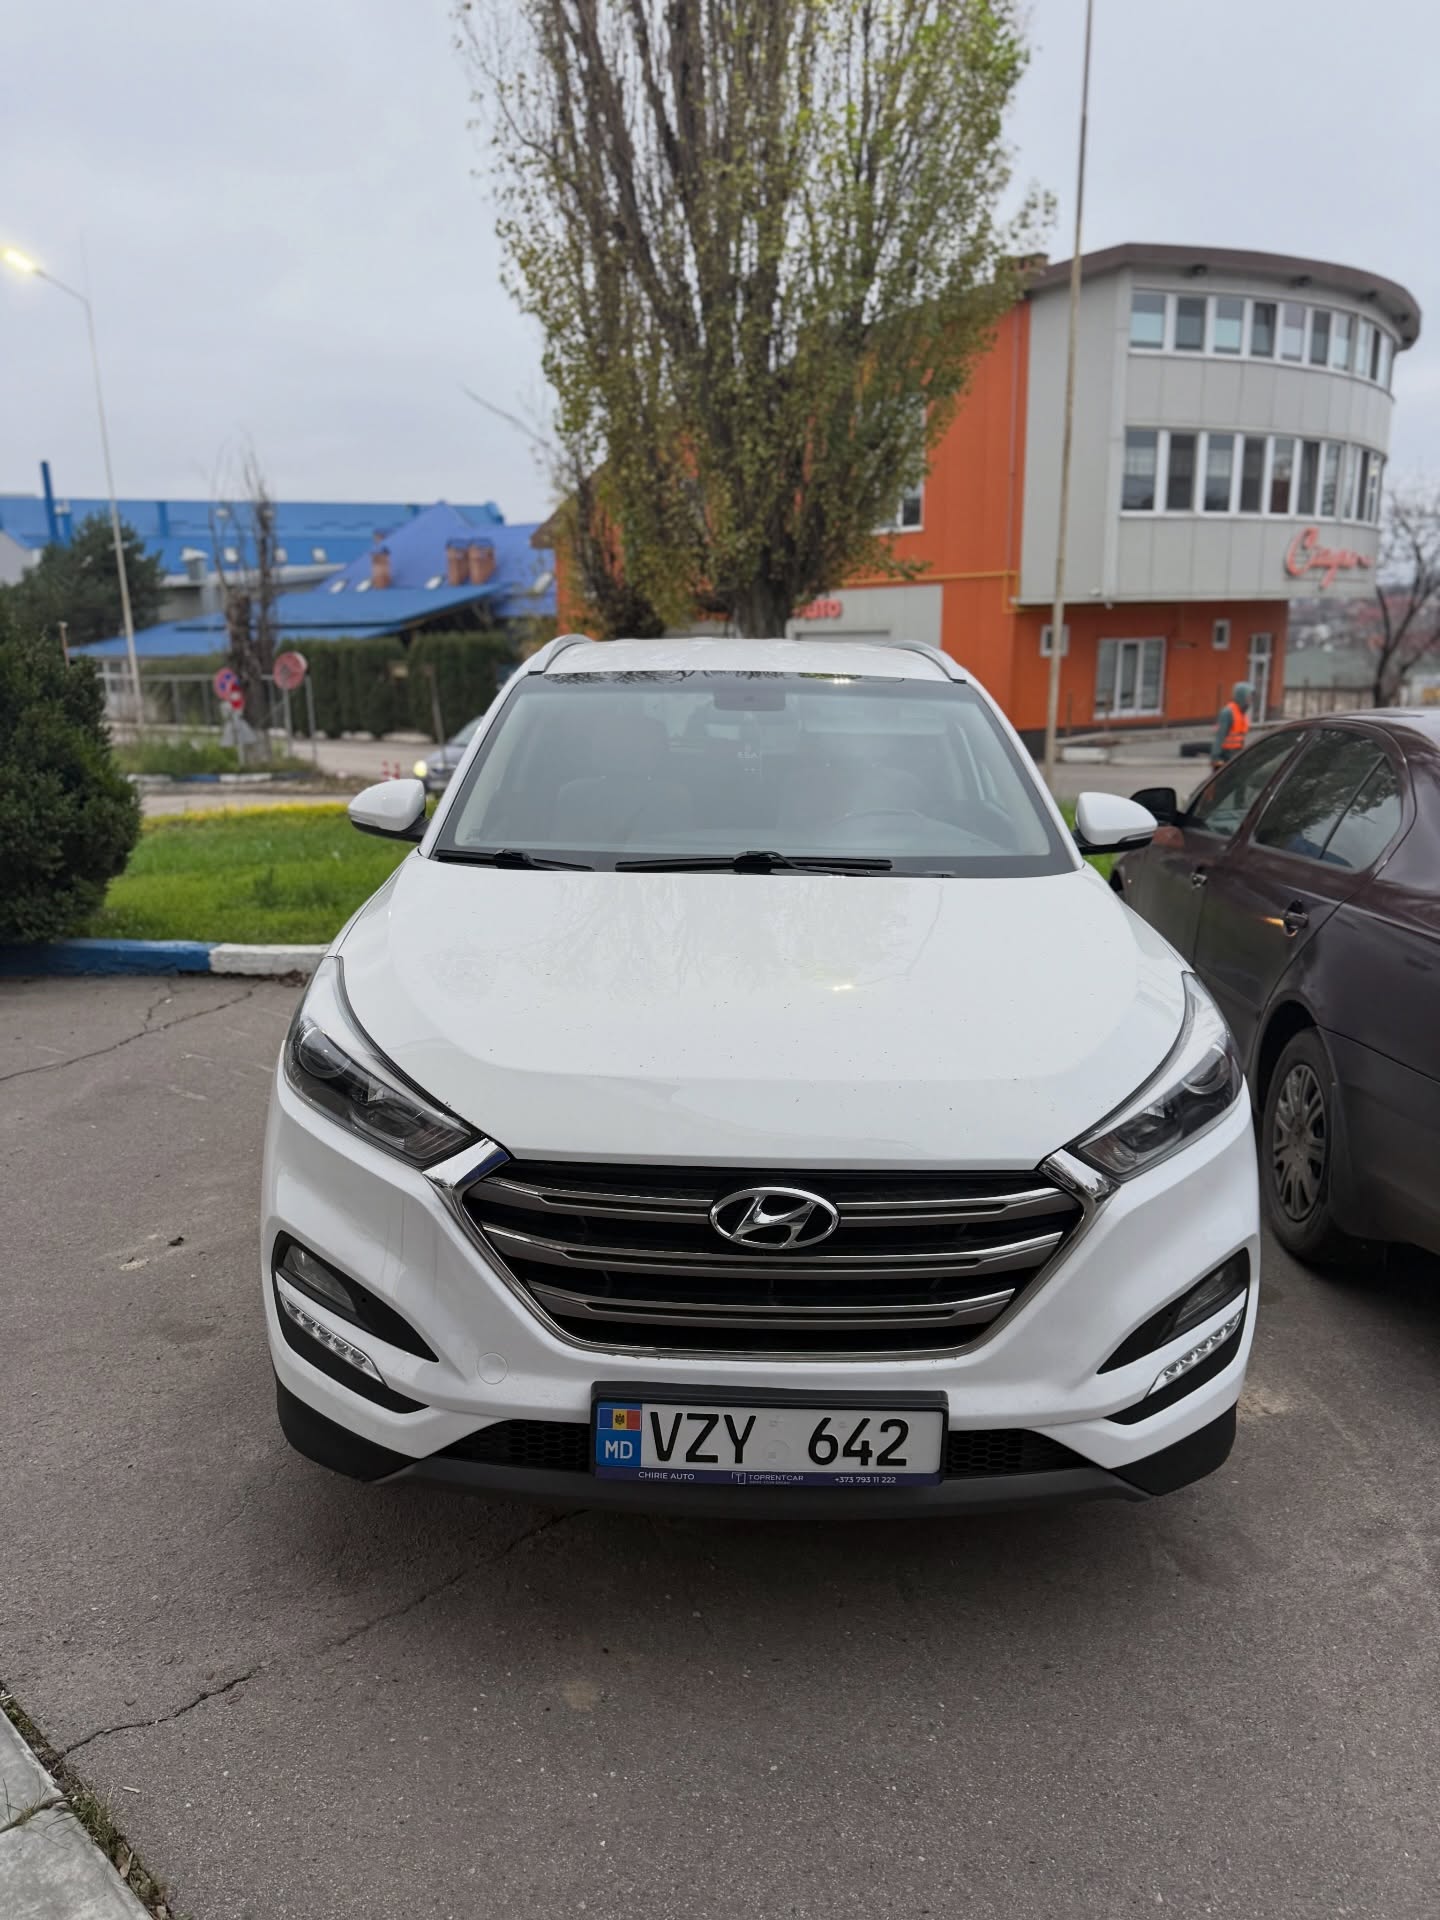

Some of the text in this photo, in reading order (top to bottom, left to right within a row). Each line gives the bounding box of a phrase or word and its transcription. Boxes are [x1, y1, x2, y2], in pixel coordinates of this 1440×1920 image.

[650, 1411, 909, 1467] VZY 642
[605, 1440, 632, 1459] MD
[638, 1471, 668, 1479] CHIRIE
[873, 1476, 880, 1484] 11
[881, 1476, 897, 1484] 222
